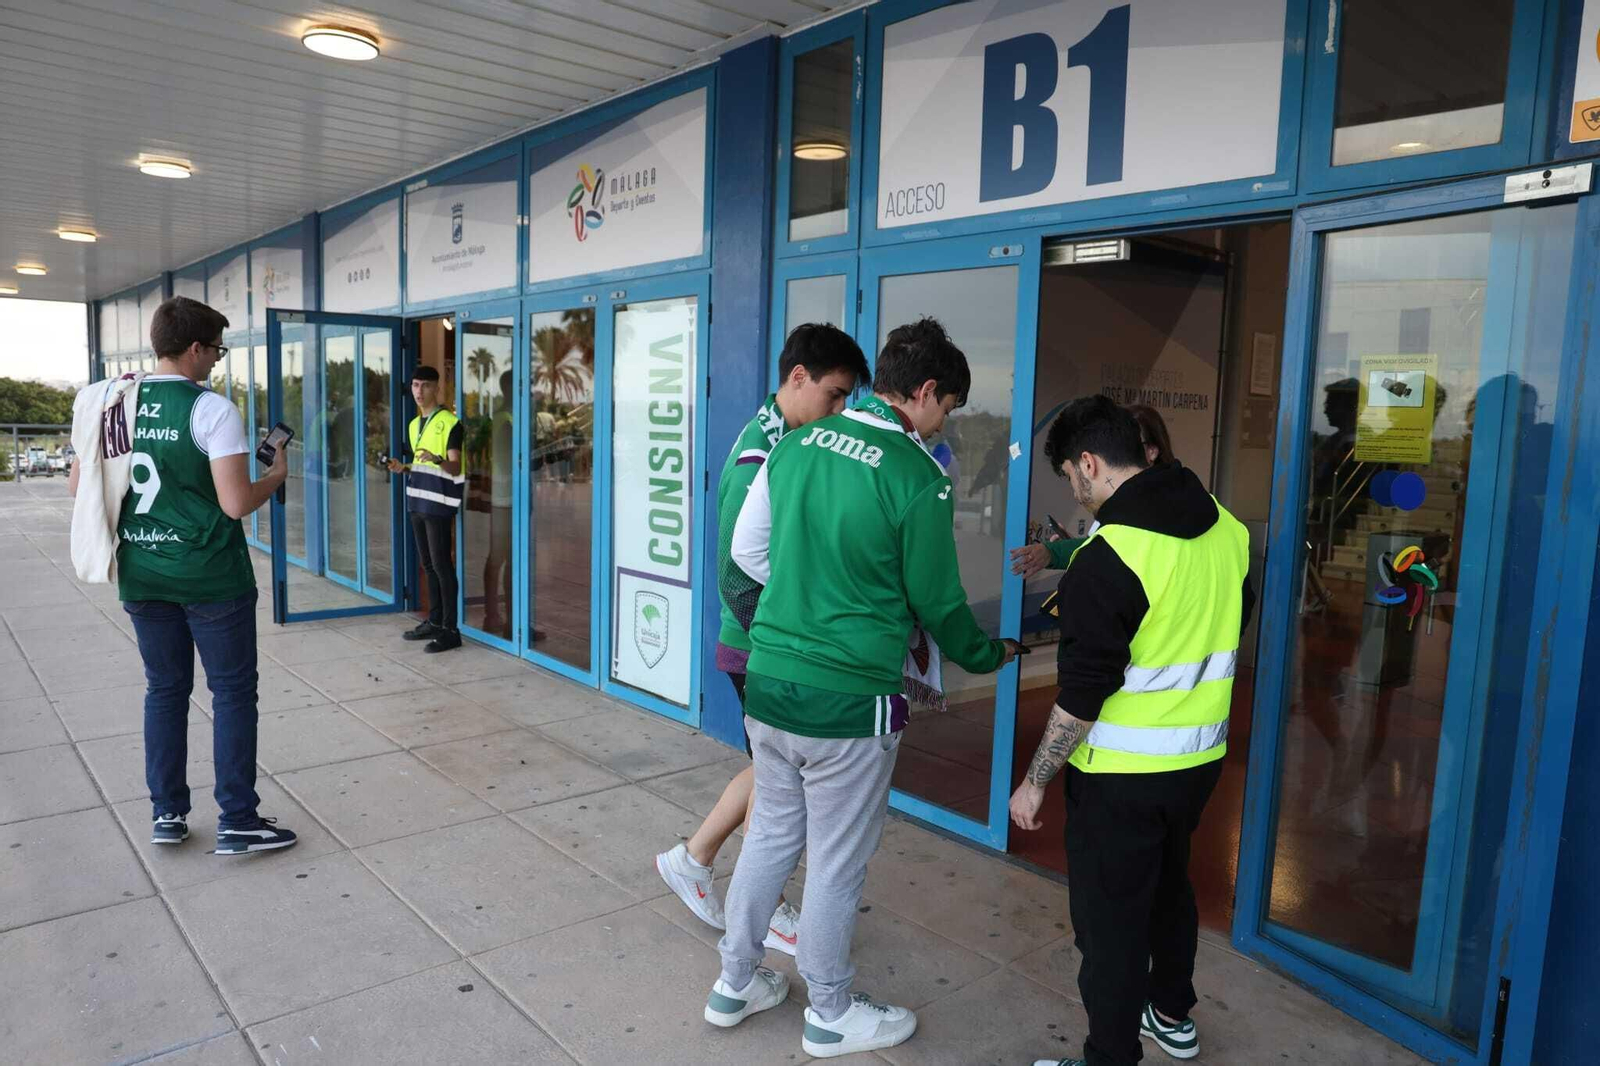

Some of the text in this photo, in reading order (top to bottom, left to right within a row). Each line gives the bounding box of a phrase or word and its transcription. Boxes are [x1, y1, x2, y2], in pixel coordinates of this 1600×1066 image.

[979, 3, 1131, 203] B1
[610, 166, 657, 196] MÁLAGA
[885, 182, 945, 219] ACCESO
[1173, 391, 1209, 411] CARPENA
[648, 333, 684, 568] CONSIGNA
[130, 452, 161, 515] 9
[123, 527, 184, 543] Andalucía
